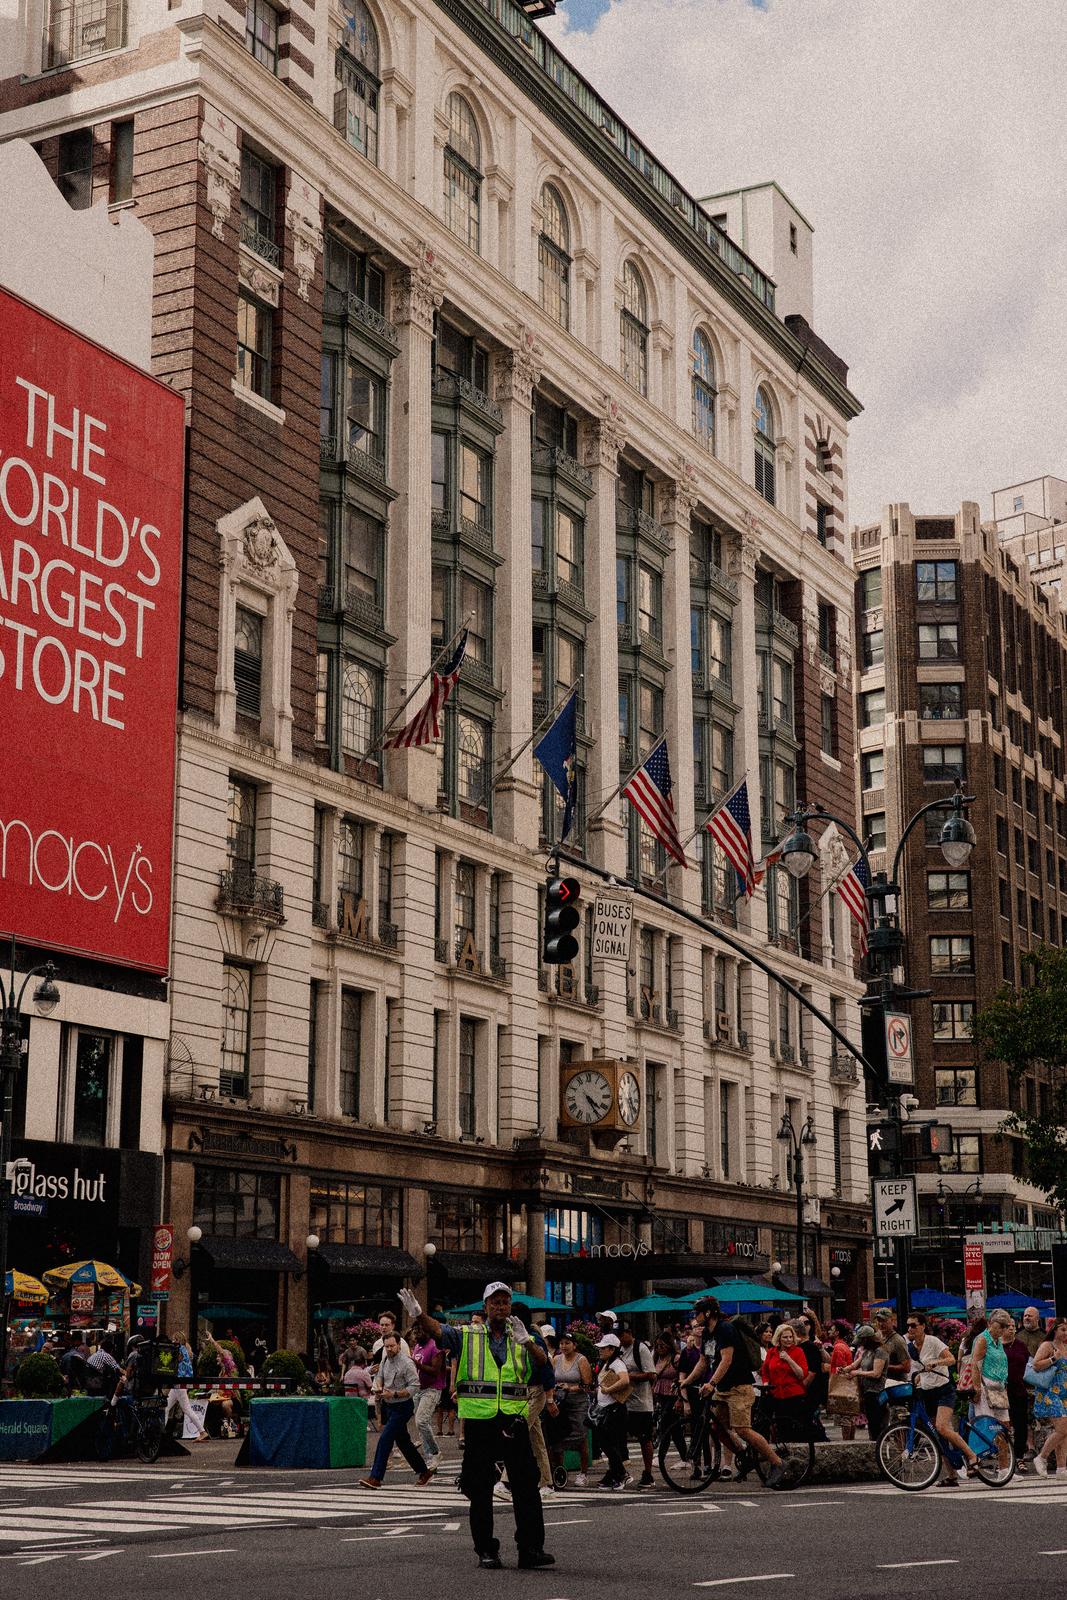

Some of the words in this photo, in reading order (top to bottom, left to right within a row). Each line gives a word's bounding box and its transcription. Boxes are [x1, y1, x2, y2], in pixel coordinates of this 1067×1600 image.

[15, 375, 108, 486] THE
[0, 449, 162, 587] ORLD'S
[0, 539, 156, 659] RGEST
[0, 616, 127, 731] TORE
[597, 902, 631, 920] BUSES
[599, 921, 628, 938] ONLY
[595, 939, 627, 956] SIGNAL
[73, 1168, 107, 1203] hut
[880, 1184, 908, 1196] KEEP
[13, 1200, 43, 1215] Broadway
[880, 1220, 912, 1231] RIGHT
[154, 1252, 171, 1260] NOW
[152, 1261, 172, 1269] OPEN
[23, 1422, 48, 1438] Square
